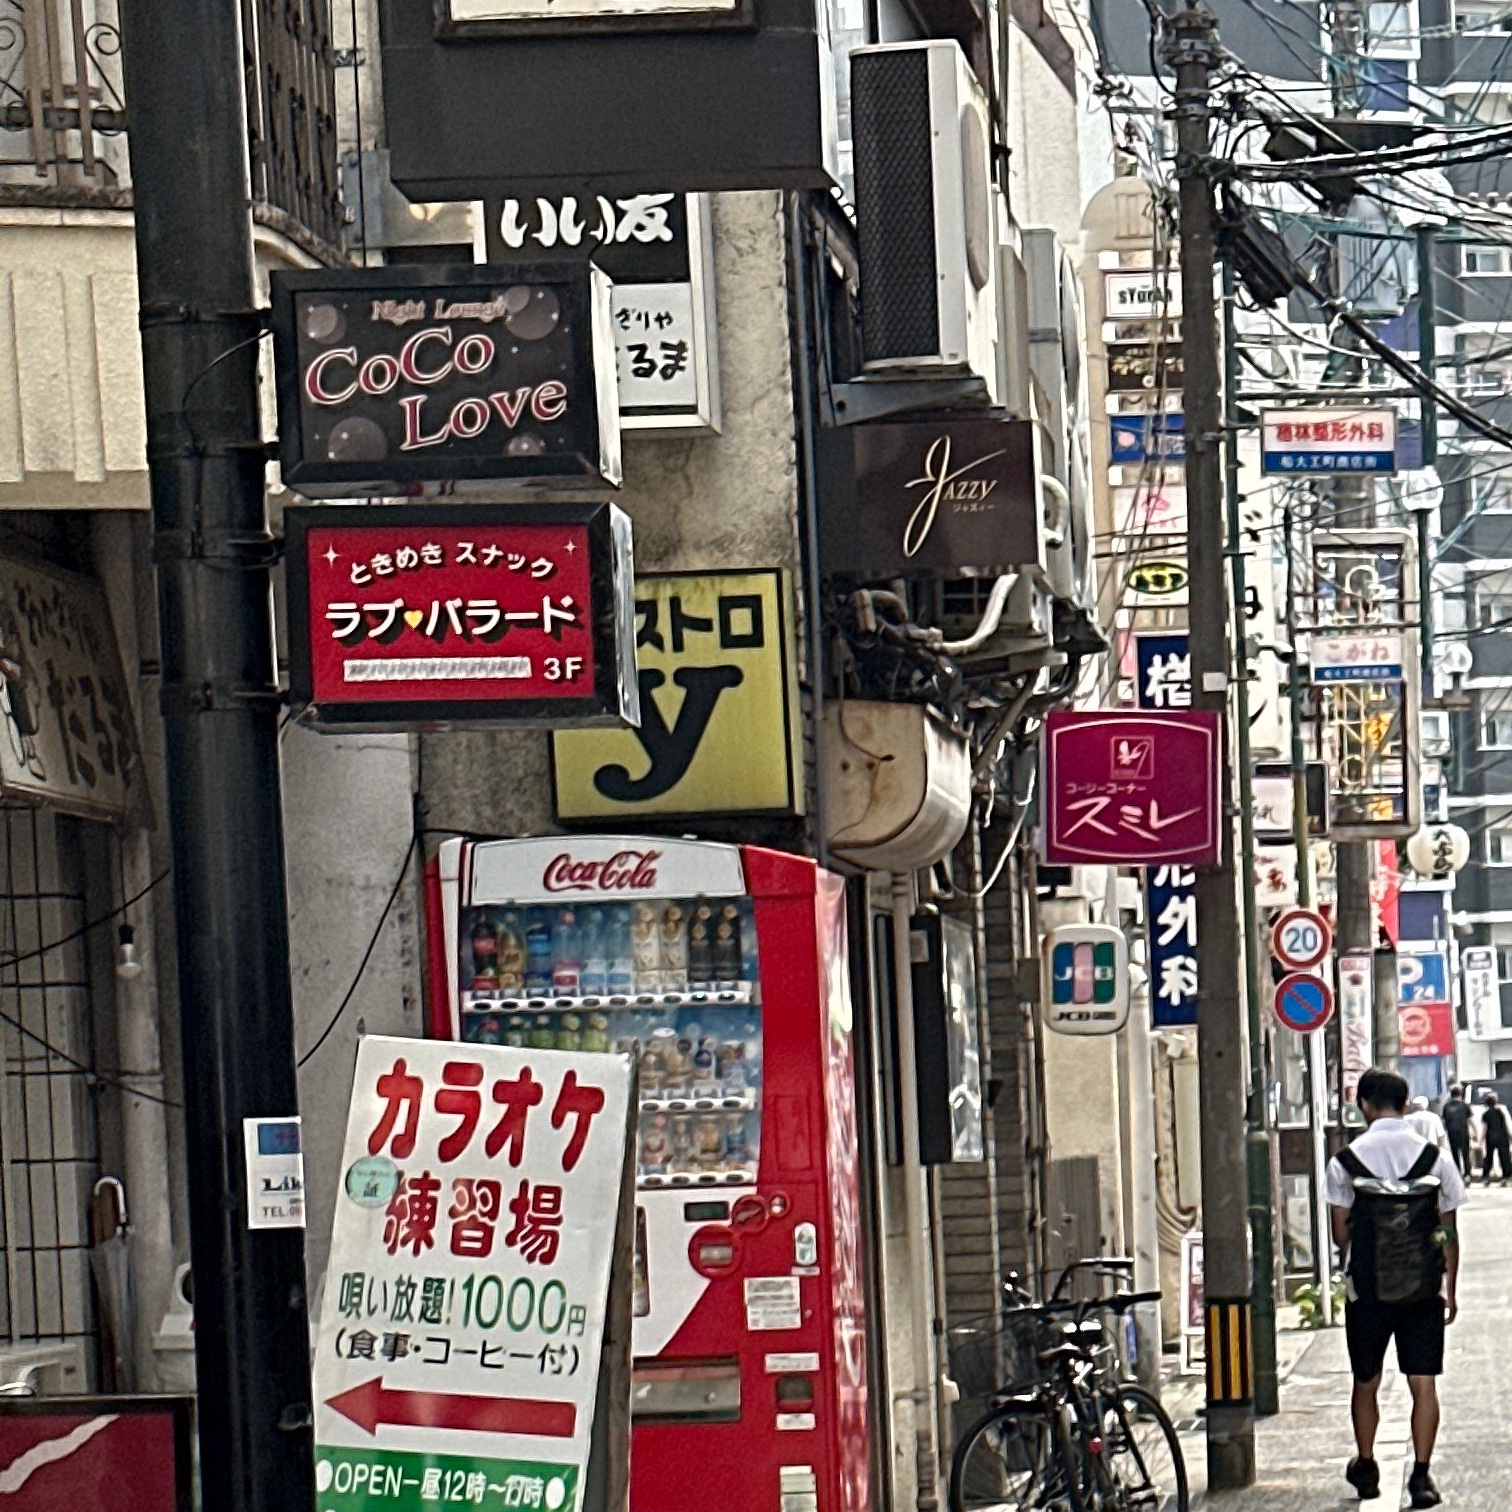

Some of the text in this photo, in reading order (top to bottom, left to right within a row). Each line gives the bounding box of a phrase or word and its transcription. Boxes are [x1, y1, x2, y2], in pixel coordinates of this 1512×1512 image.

[501, 193, 675, 248] いい友
[305, 325, 496, 406] CoCo
[616, 339, 688, 381] るま
[398, 380, 569, 452] Love
[350, 542, 554, 585] ときめき スナック
[543, 657, 583, 680] 3F
[1061, 796, 1202, 842] スミレ
[1284, 925, 1319, 953] 20
[368, 1057, 606, 1173] カラオケ
[383, 1170, 564, 1266] 練習場
